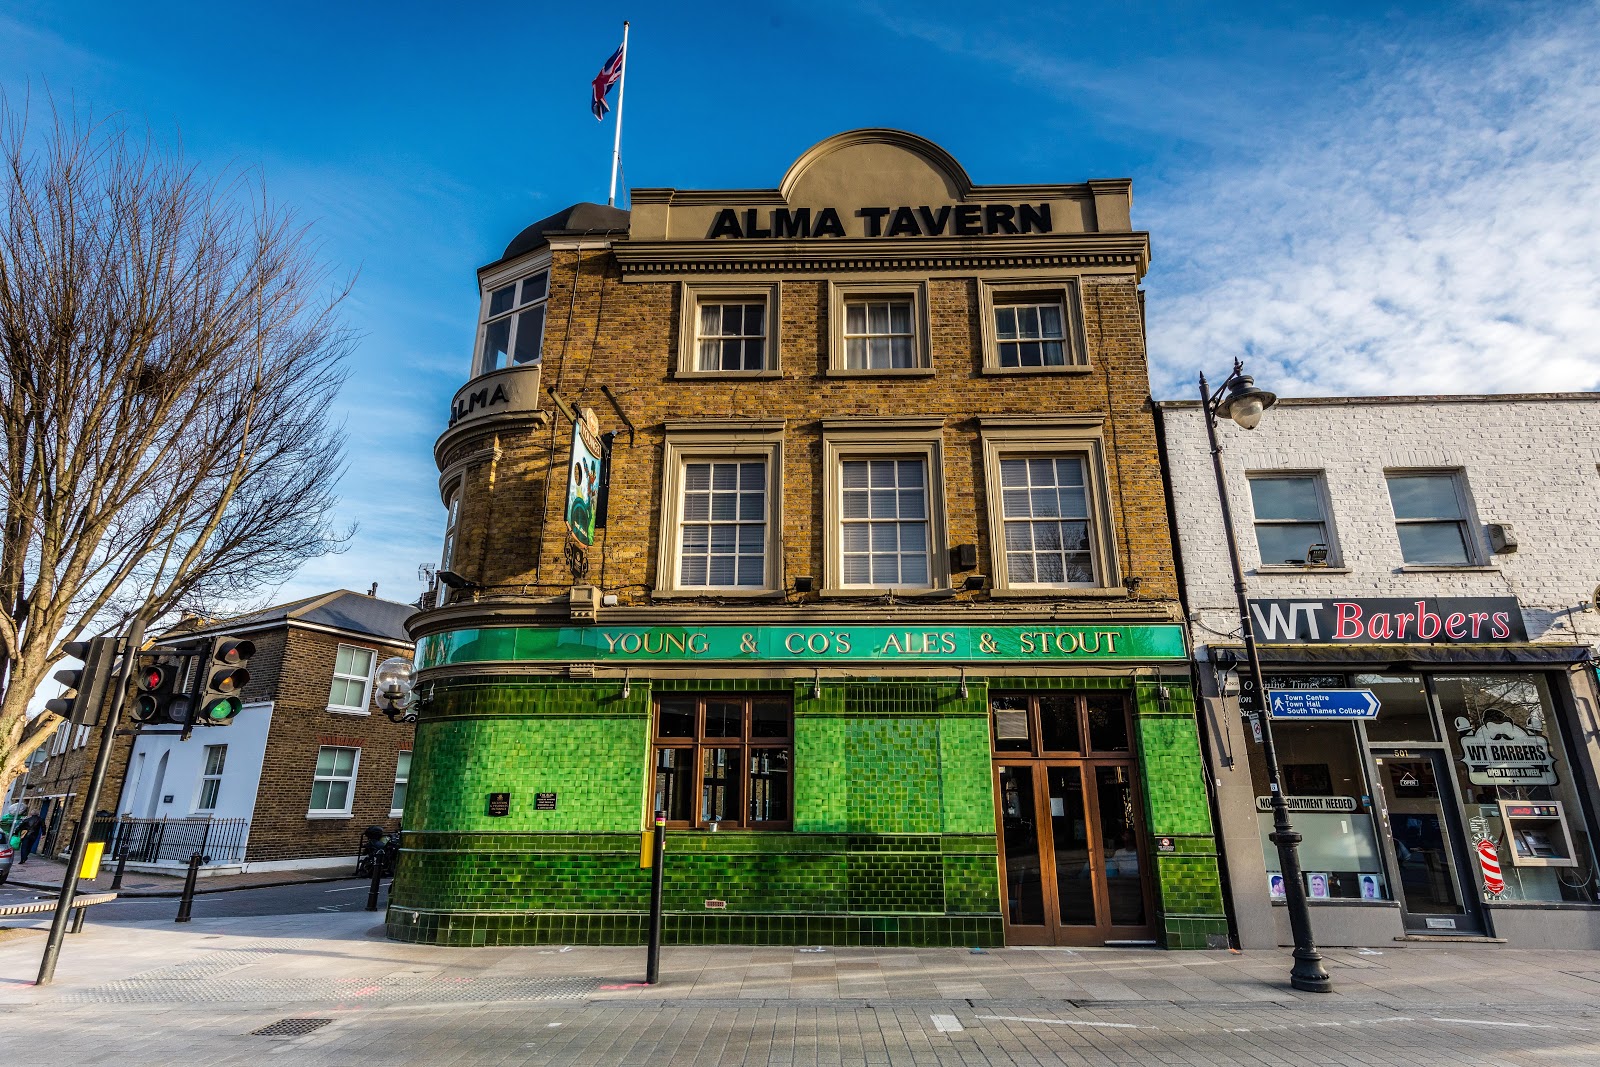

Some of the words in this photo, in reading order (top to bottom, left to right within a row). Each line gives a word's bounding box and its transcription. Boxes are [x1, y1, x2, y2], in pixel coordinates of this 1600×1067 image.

[710, 207, 846, 239] ALMA
[860, 203, 1051, 237] TAVERN
[1250, 603, 1323, 640] WT
[1332, 601, 1510, 639] Barbers
[603, 632, 710, 654] YOUNG
[740, 632, 760, 654] &
[785, 631, 852, 654] CO'S
[882, 632, 957, 653] ALES
[979, 632, 1002, 654] &
[1020, 632, 1122, 654] STOUT
[1394, 749, 1409, 757] 501
[1466, 745, 1488, 761] WT
[1490, 745, 1547, 761] BARBERS
[1260, 798, 1271, 809] NO
[1325, 798, 1353, 809] NEEDED
